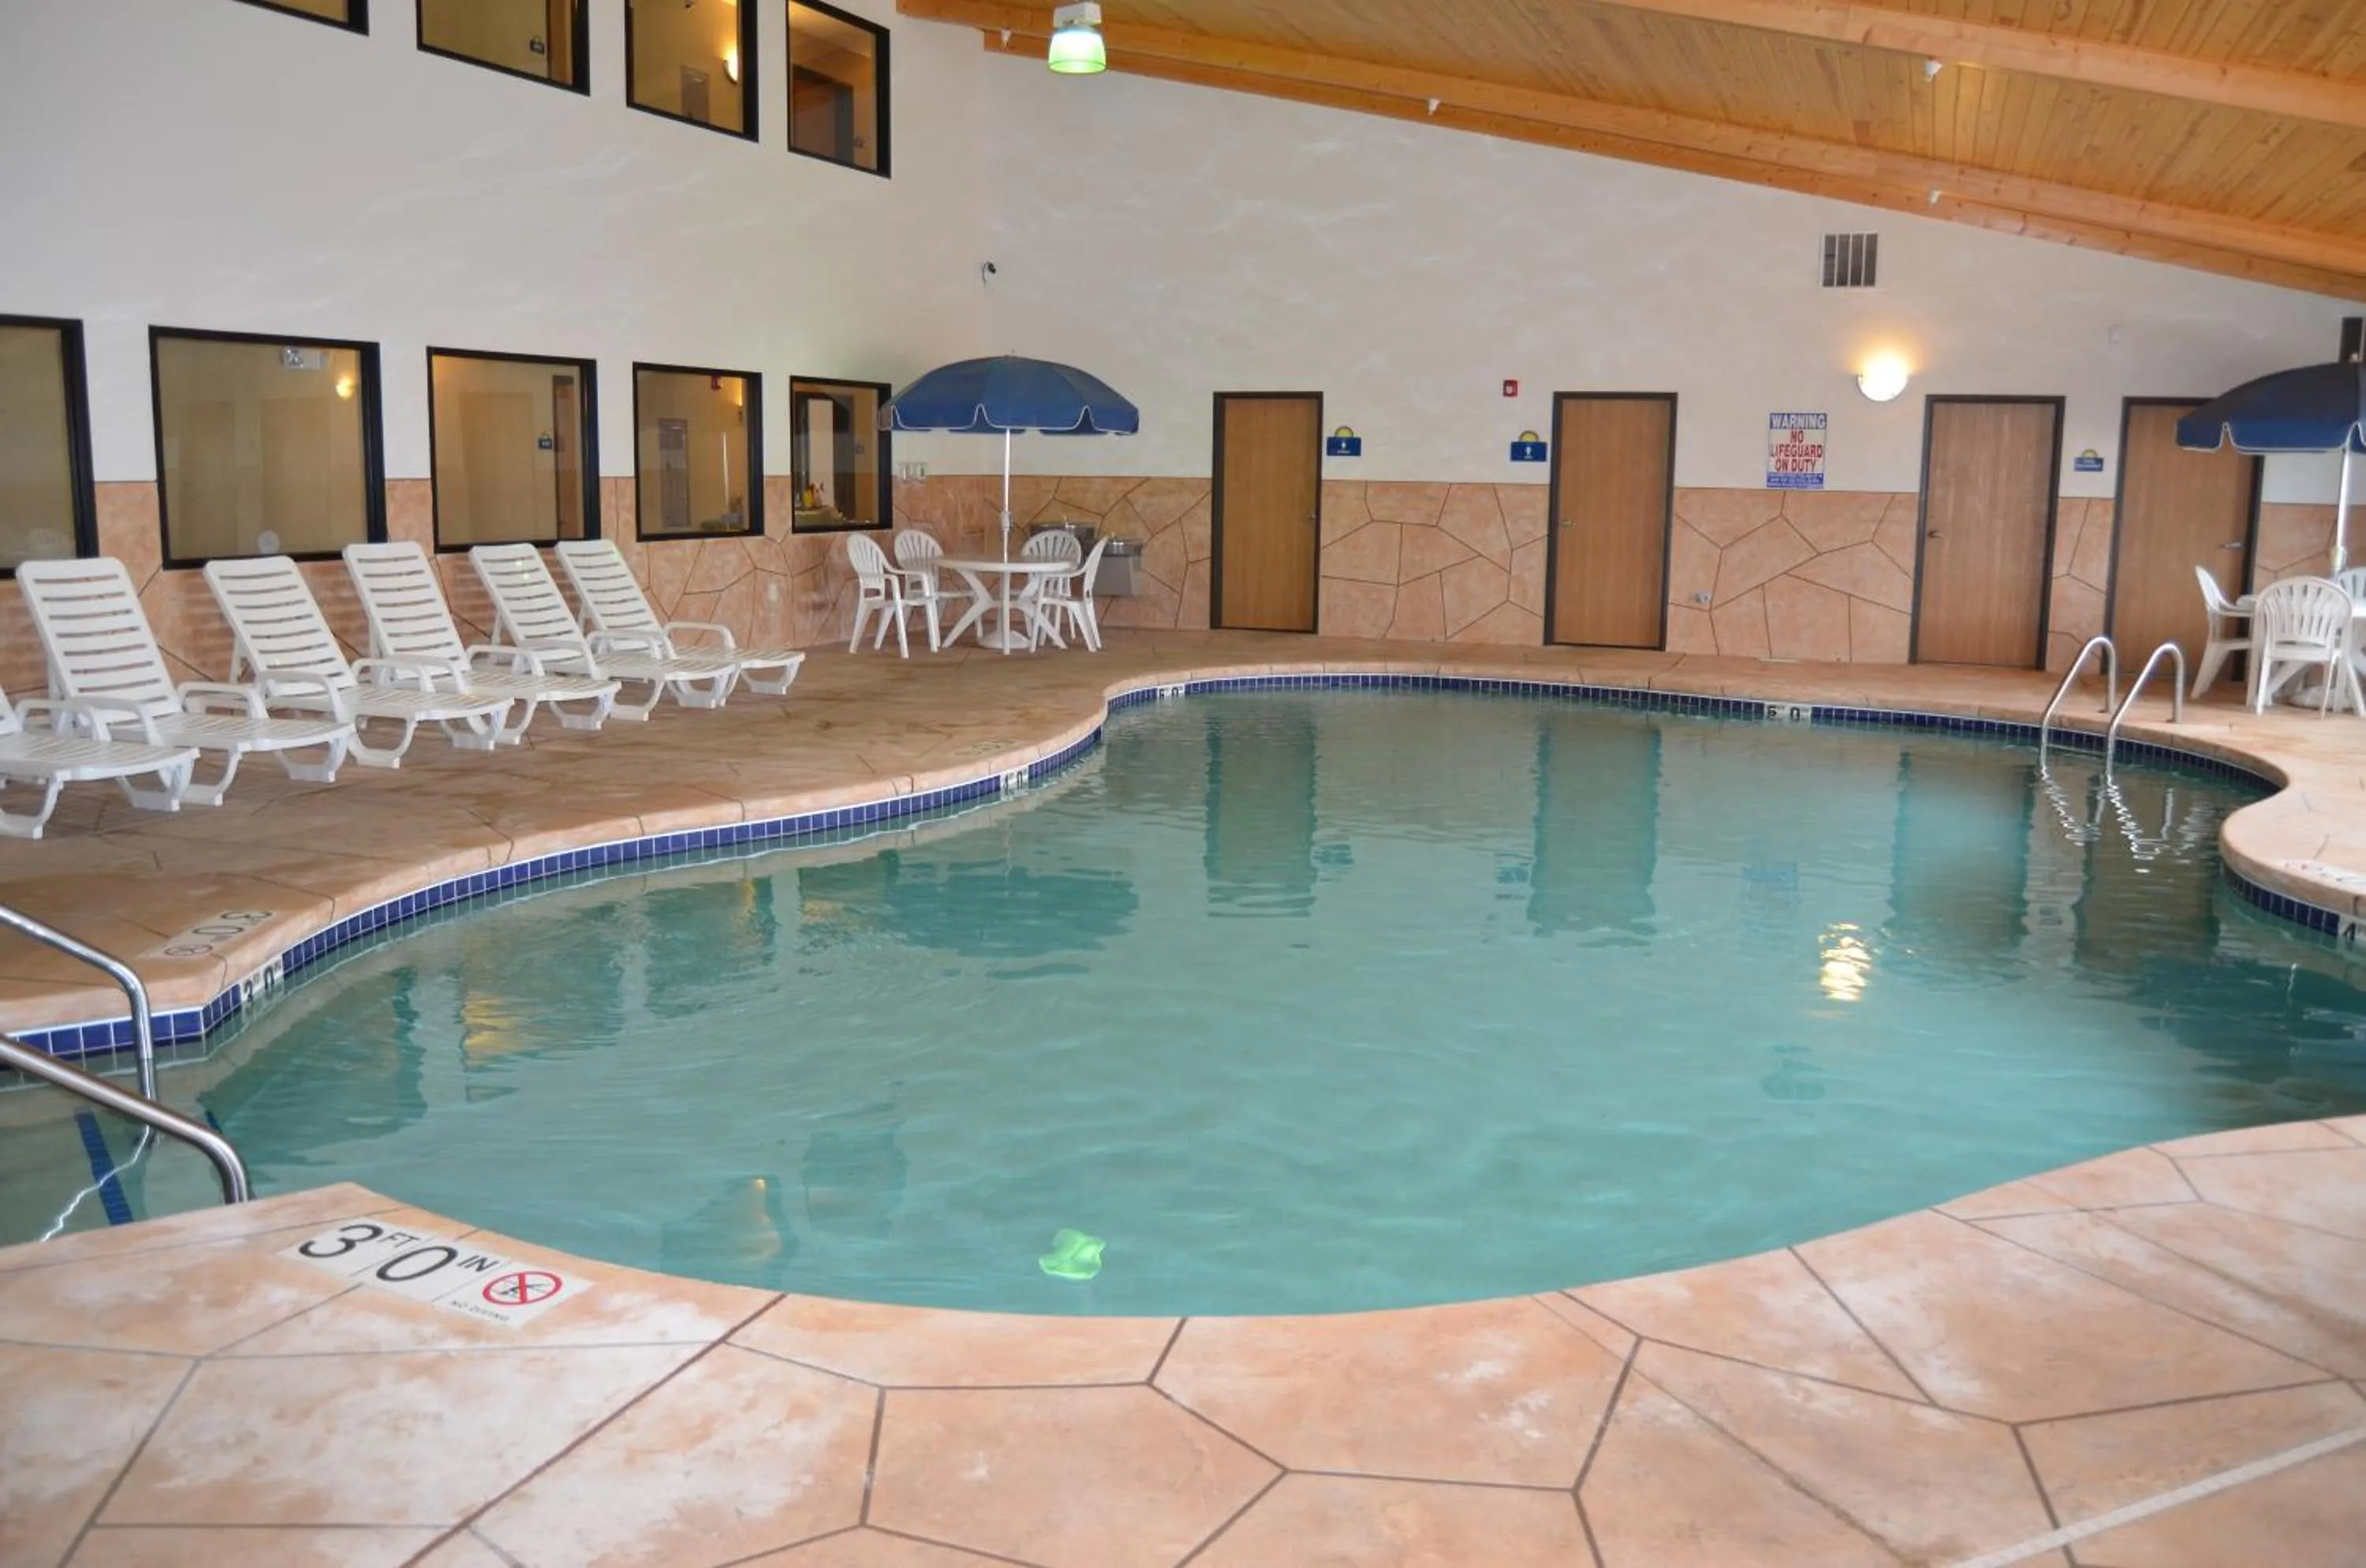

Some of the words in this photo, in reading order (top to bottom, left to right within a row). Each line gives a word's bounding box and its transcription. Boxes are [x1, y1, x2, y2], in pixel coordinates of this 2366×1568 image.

[1771, 415, 1826, 428] WARNING
[1791, 430, 1804, 443] NO
[1771, 444, 1823, 457] LIFEGUARD
[1775, 458, 1788, 472] ON
[1791, 458, 1816, 472] DUTY
[299, 1223, 383, 1258] 3
[379, 1231, 423, 1248] FT
[375, 1245, 459, 1282] 0
[457, 1255, 499, 1273] IN
